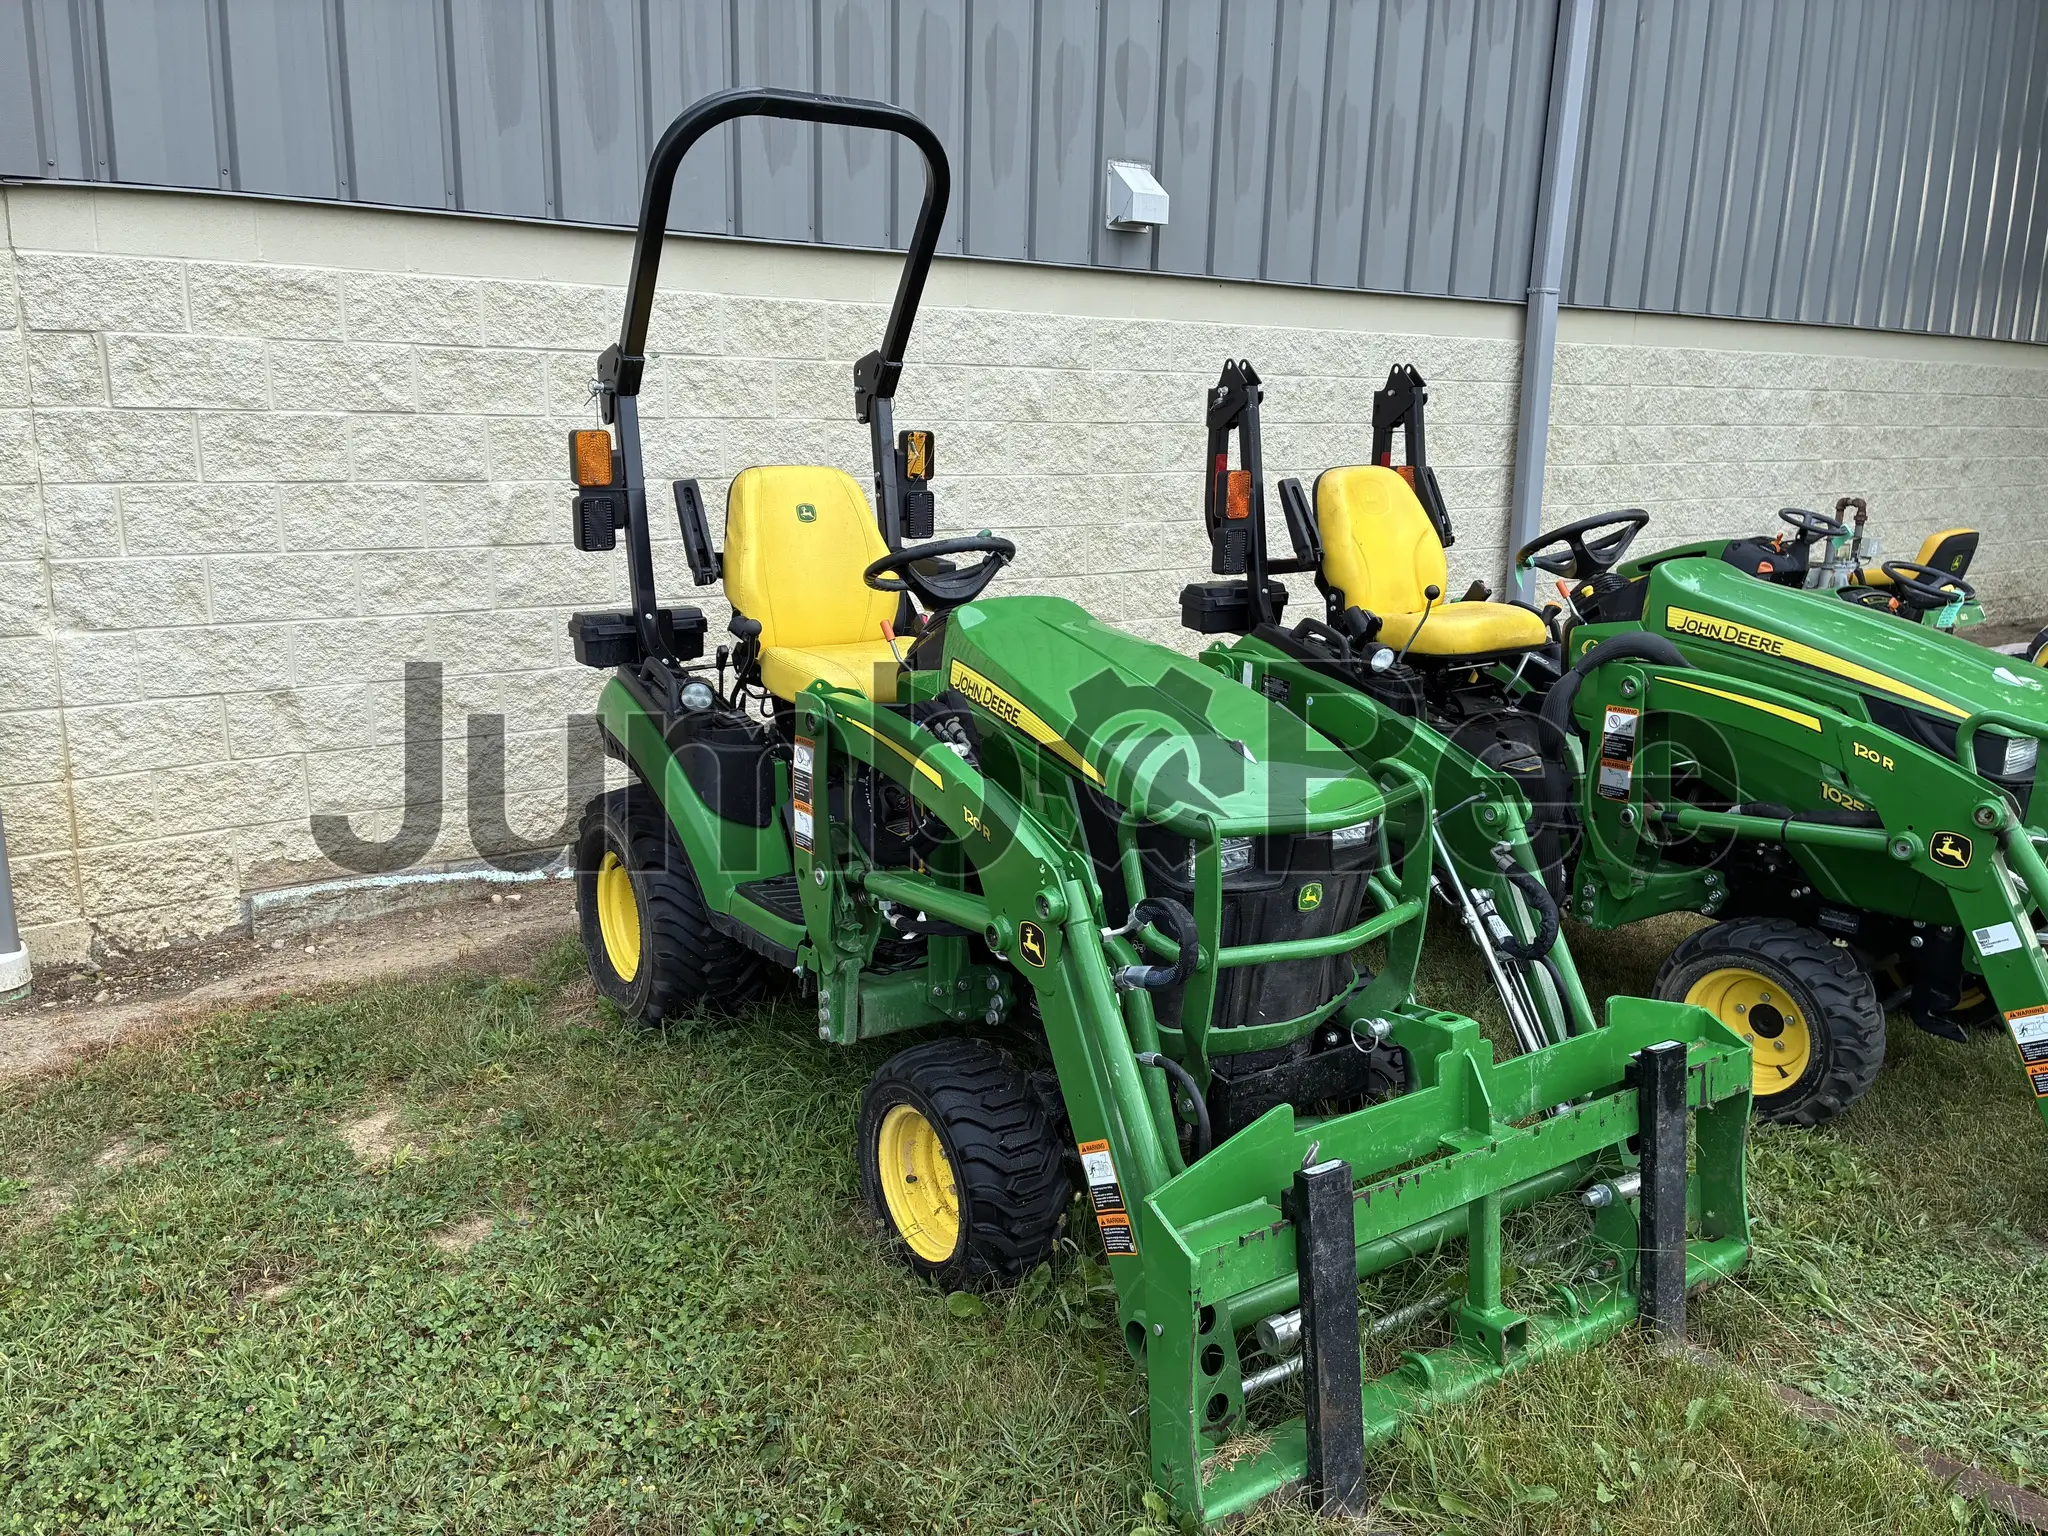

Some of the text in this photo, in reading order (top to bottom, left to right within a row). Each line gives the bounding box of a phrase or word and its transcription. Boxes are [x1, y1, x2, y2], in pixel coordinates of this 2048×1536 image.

[1677, 616, 1784, 655] JOHN DEERE
[954, 671, 1021, 726] JOHN DEERE
[1612, 706, 1638, 716] WARNING
[1852, 741, 1895, 772] 120 R
[1820, 781, 1874, 812] 1025
[962, 804, 992, 844] 120 R
[2016, 1007, 2046, 1018] WARNING
